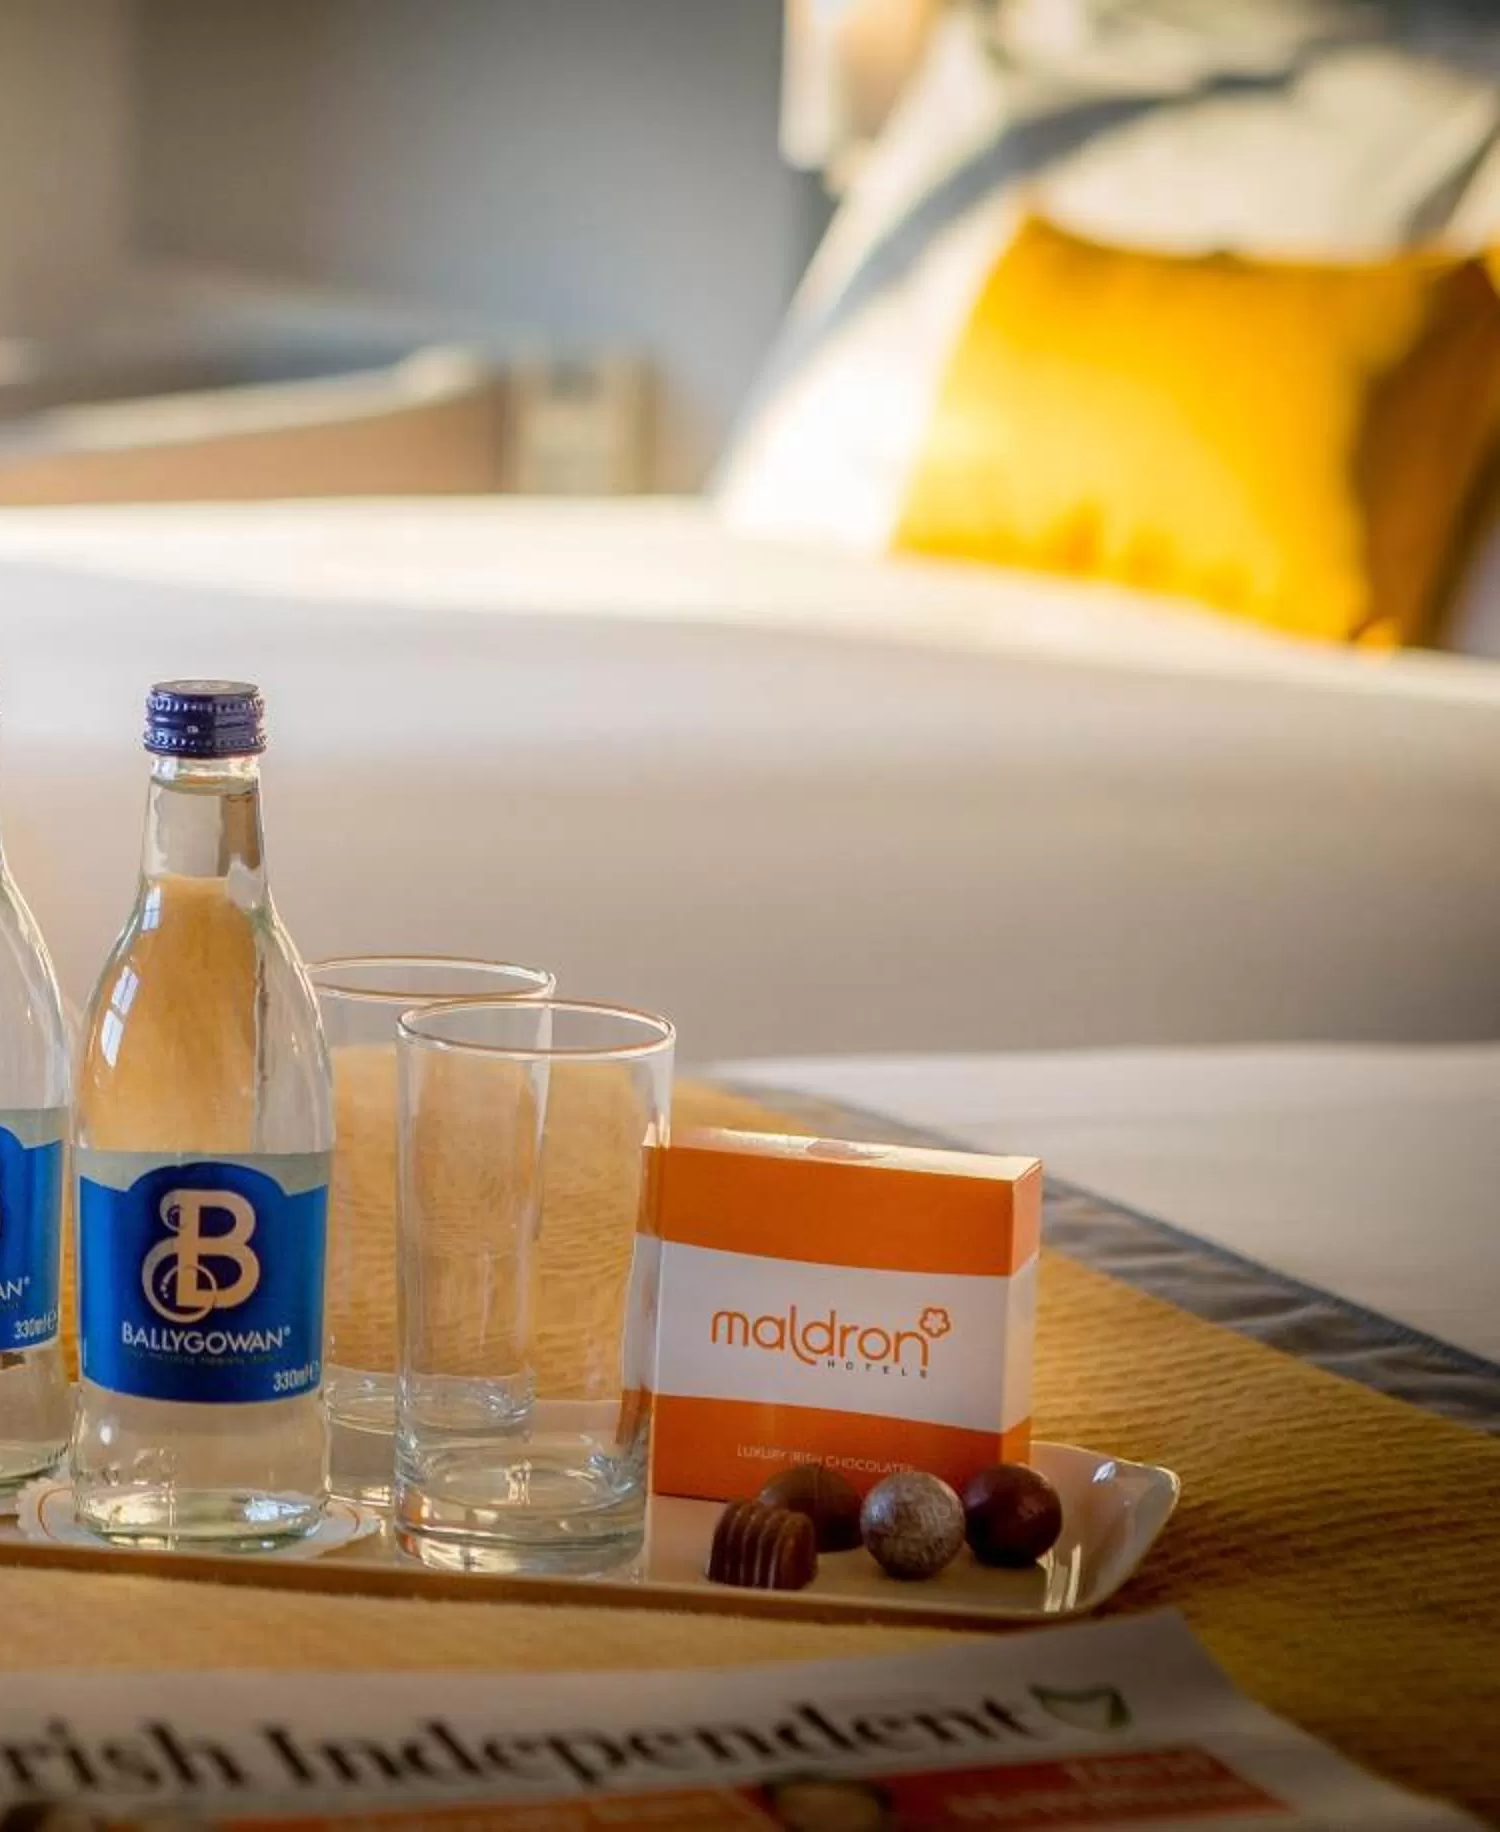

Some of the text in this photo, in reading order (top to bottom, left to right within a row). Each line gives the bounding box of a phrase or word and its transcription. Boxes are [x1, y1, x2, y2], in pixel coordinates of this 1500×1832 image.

[711, 1304, 929, 1367] maldron
[827, 1361, 929, 1379] HOTELS
[737, 1443, 786, 1461] LUXURY
[260, 1697, 1028, 1790] Independent
